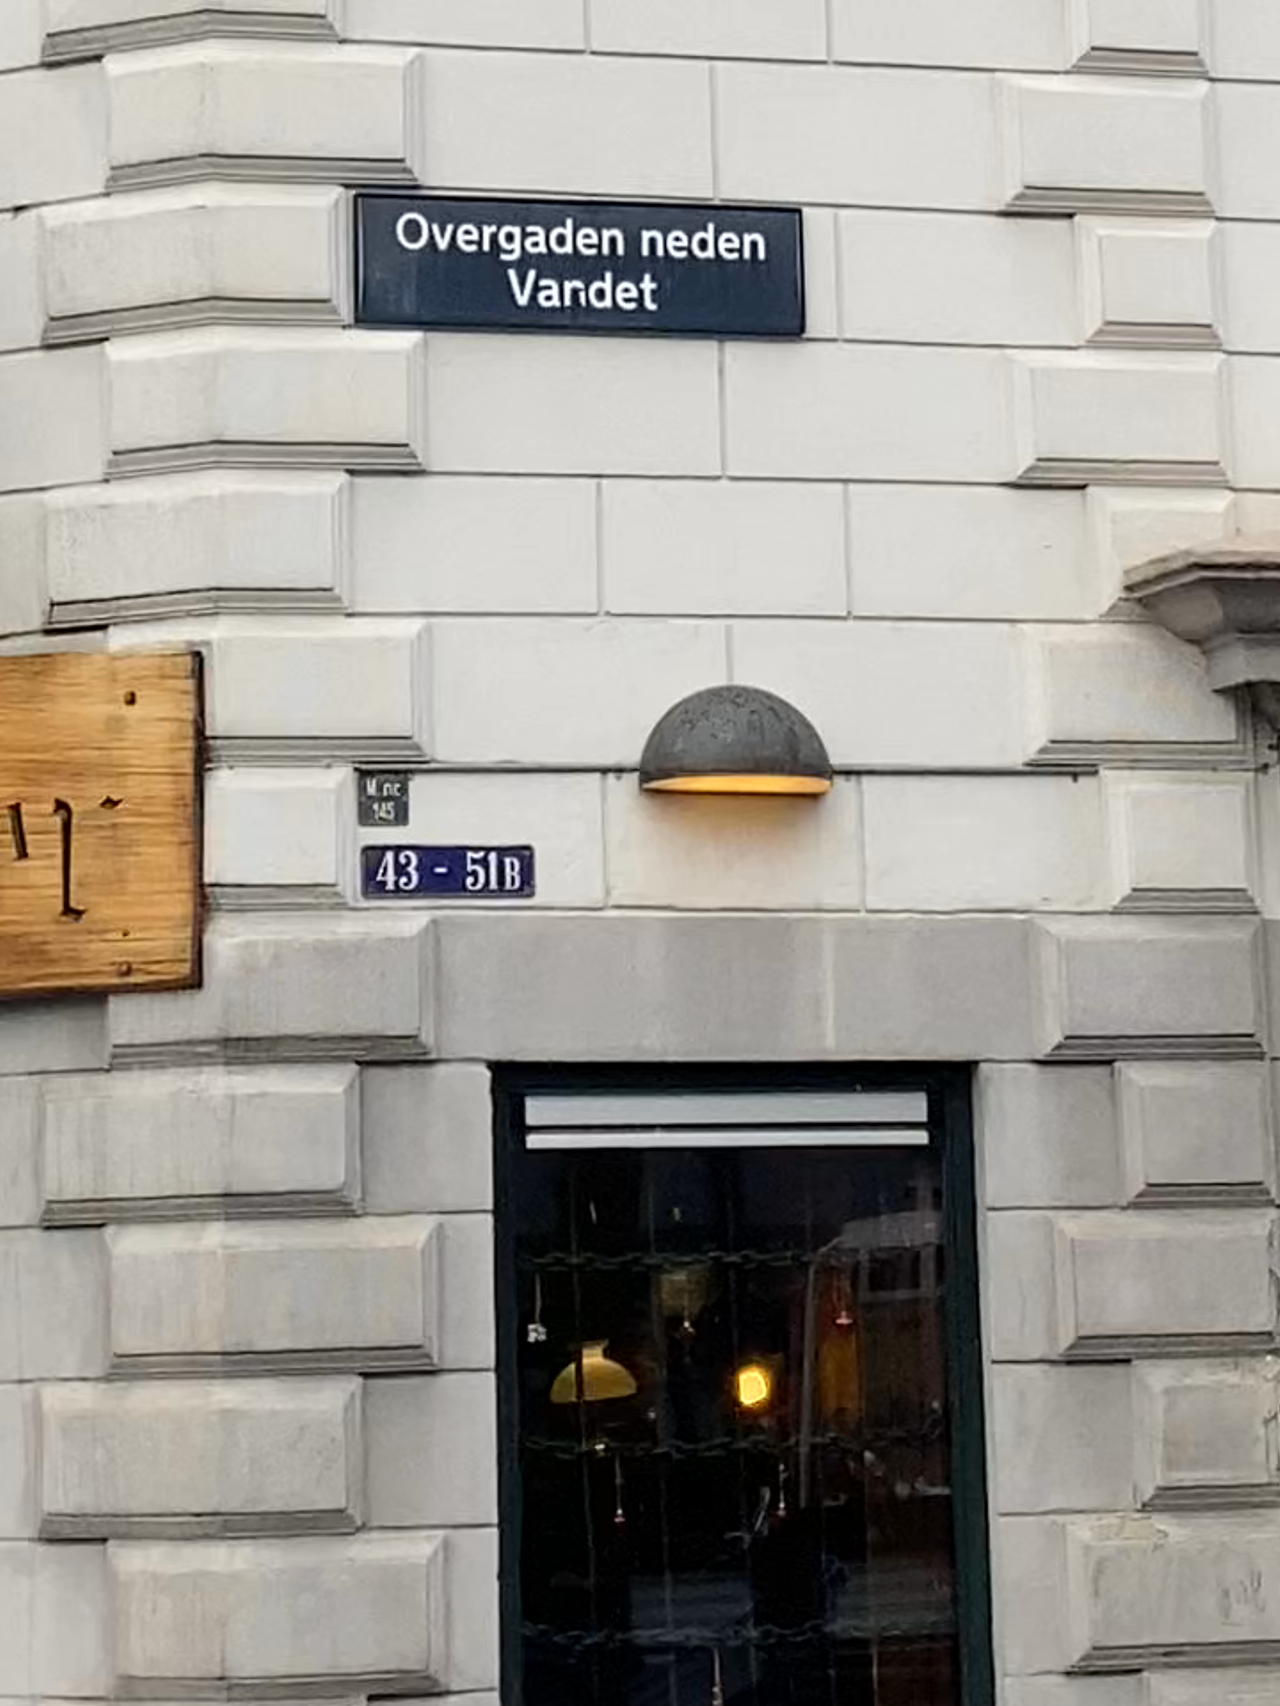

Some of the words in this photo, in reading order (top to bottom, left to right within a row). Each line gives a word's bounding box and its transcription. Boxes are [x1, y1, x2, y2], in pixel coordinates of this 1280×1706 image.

[396, 212, 624, 261] Overgaden
[640, 222, 766, 260] neden
[506, 269, 658, 311] Vandet
[376, 850, 419, 890] 43
